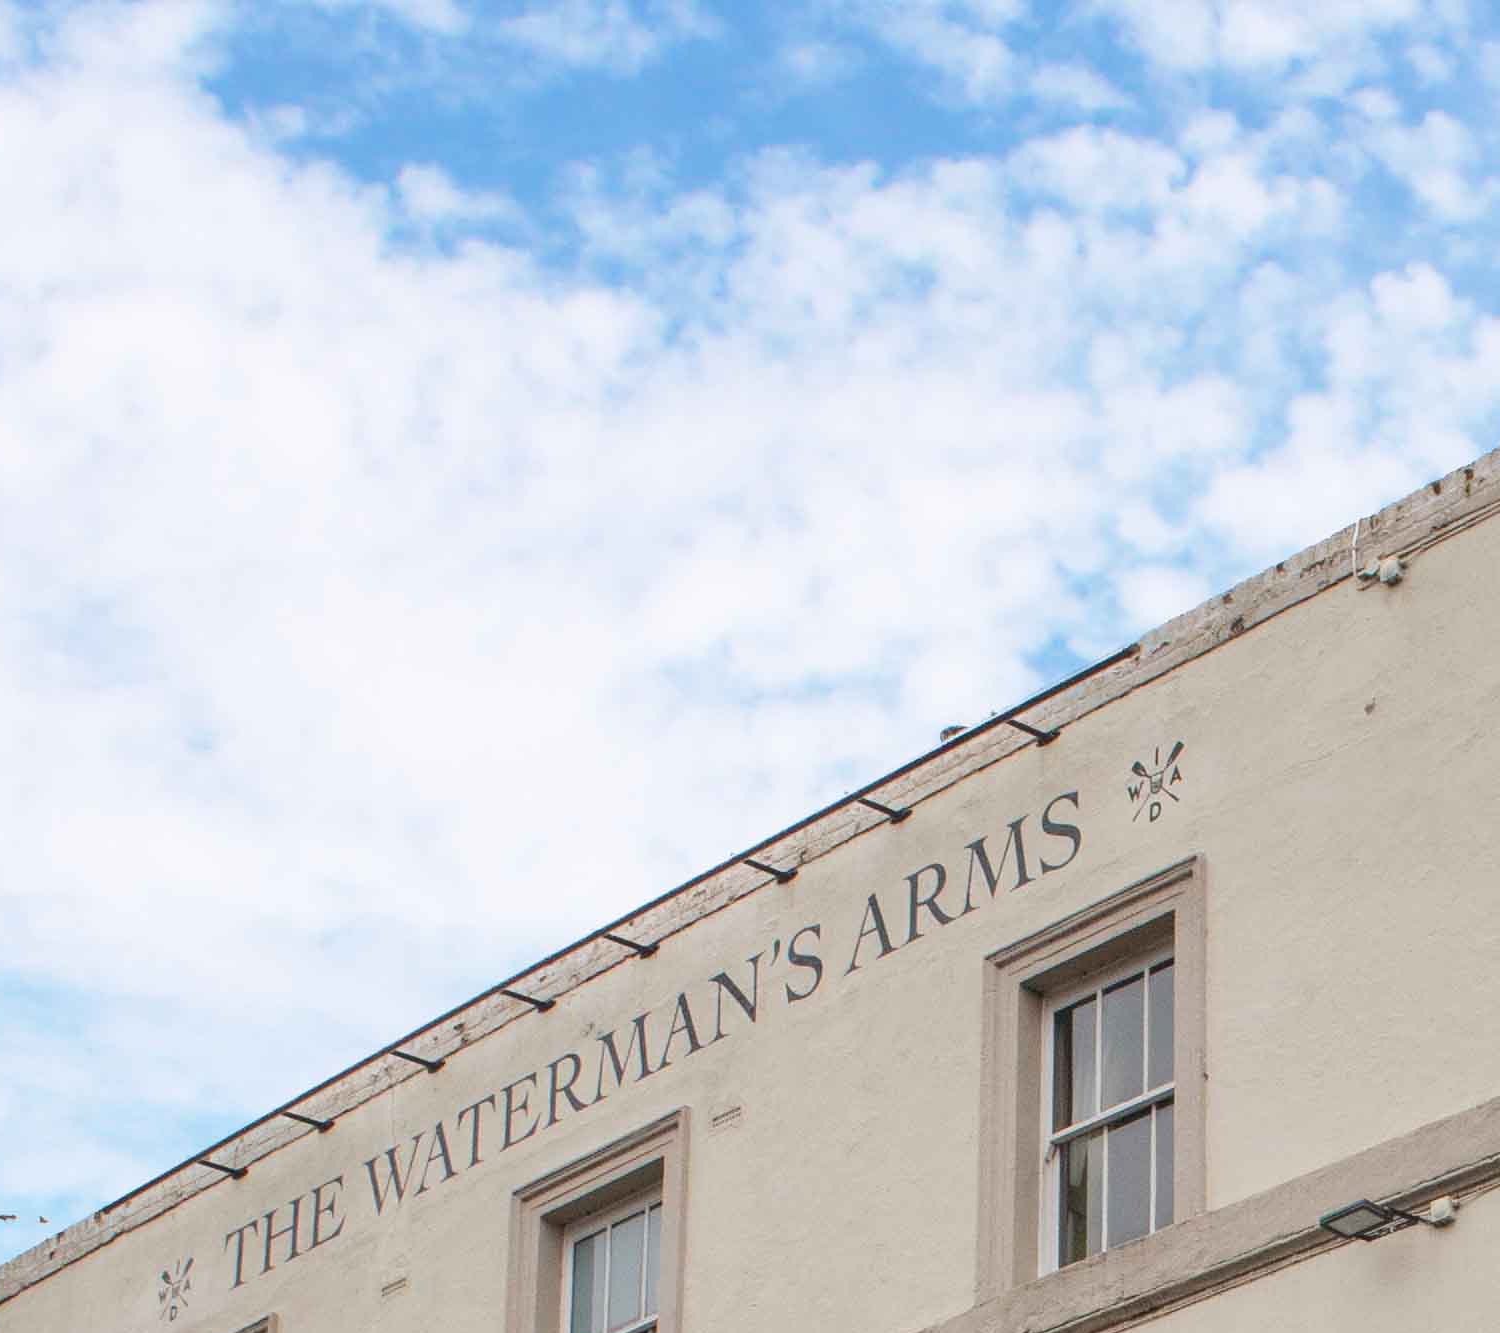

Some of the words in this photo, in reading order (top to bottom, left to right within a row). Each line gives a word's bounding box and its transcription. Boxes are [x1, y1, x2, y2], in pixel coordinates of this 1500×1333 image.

[223, 1175, 345, 1290] THE
[363, 923, 825, 1217] WATERMAN'S
[844, 791, 1083, 975] ARMS
